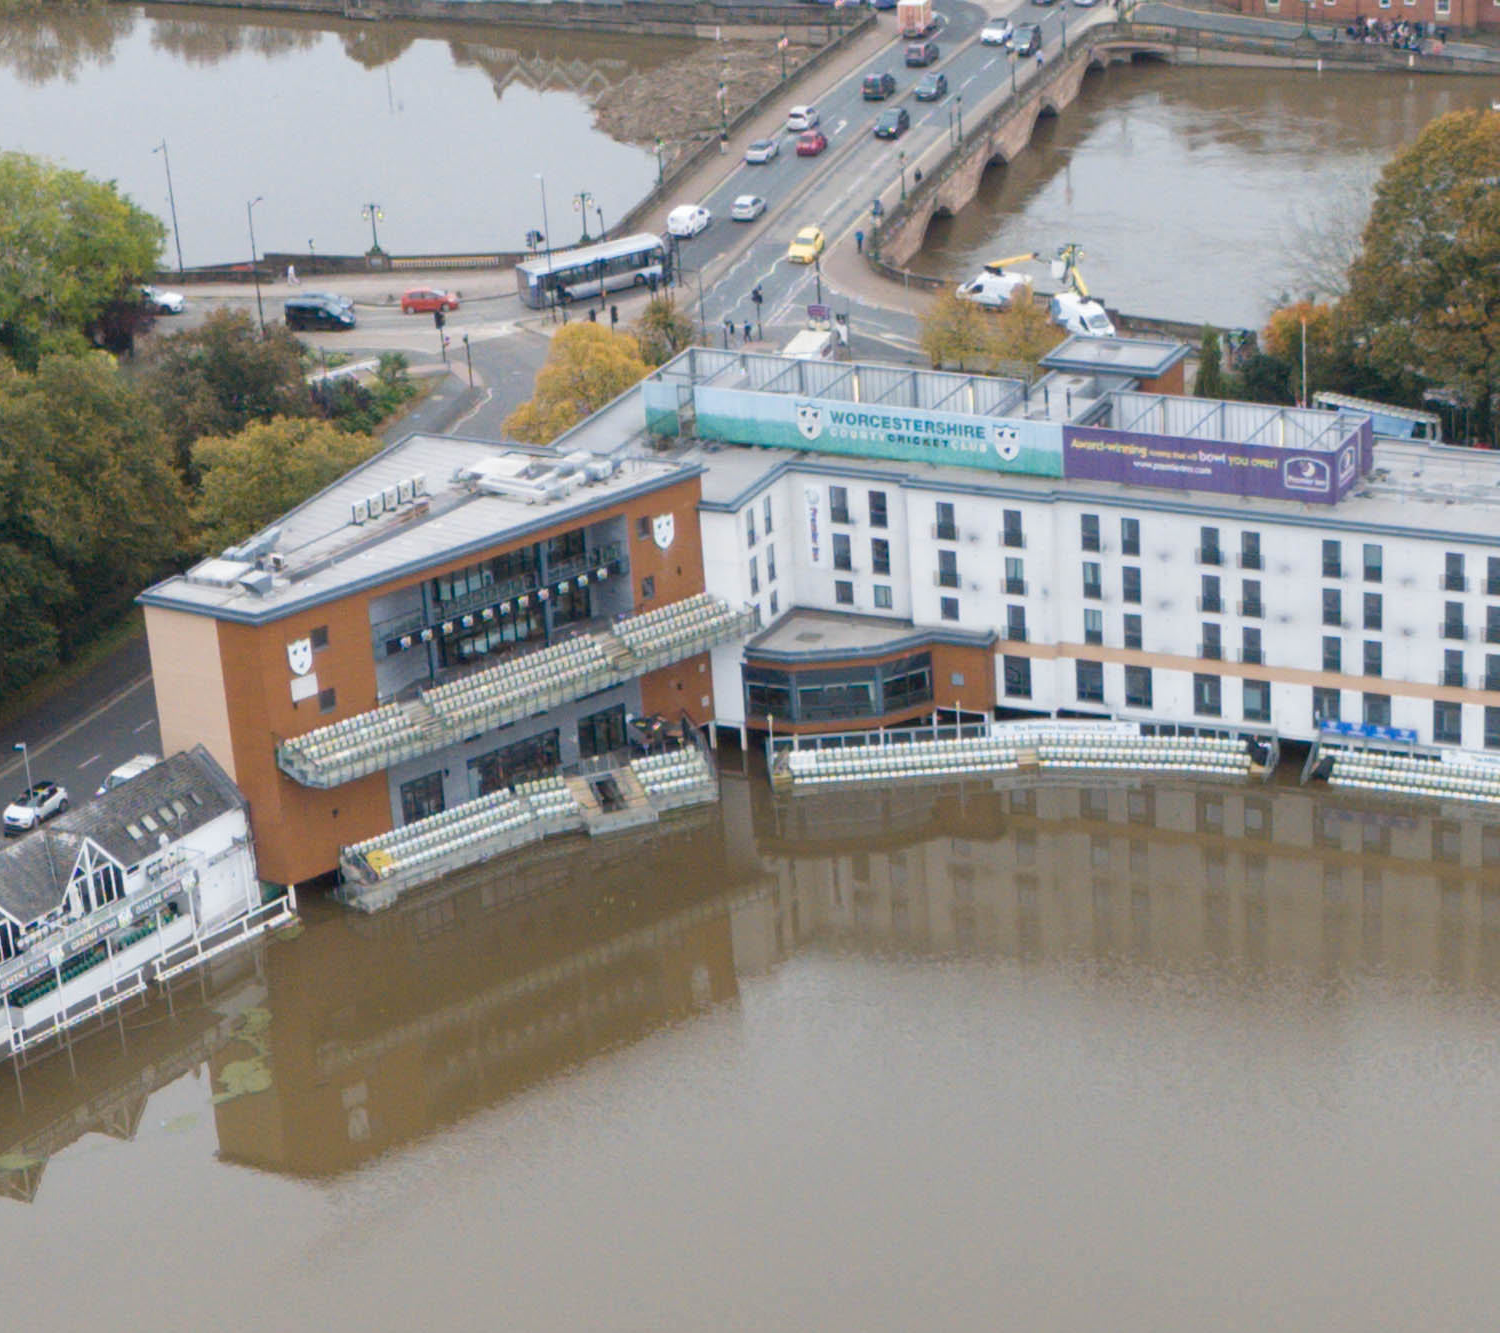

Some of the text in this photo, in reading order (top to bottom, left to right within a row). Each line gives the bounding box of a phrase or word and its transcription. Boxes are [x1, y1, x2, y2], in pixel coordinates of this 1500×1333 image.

[830, 410, 986, 439] WORCESTERSHIRE
[887, 433, 949, 449] CRICKET
[1198, 450, 1226, 464] bowl
[1228, 456, 1249, 467] you
